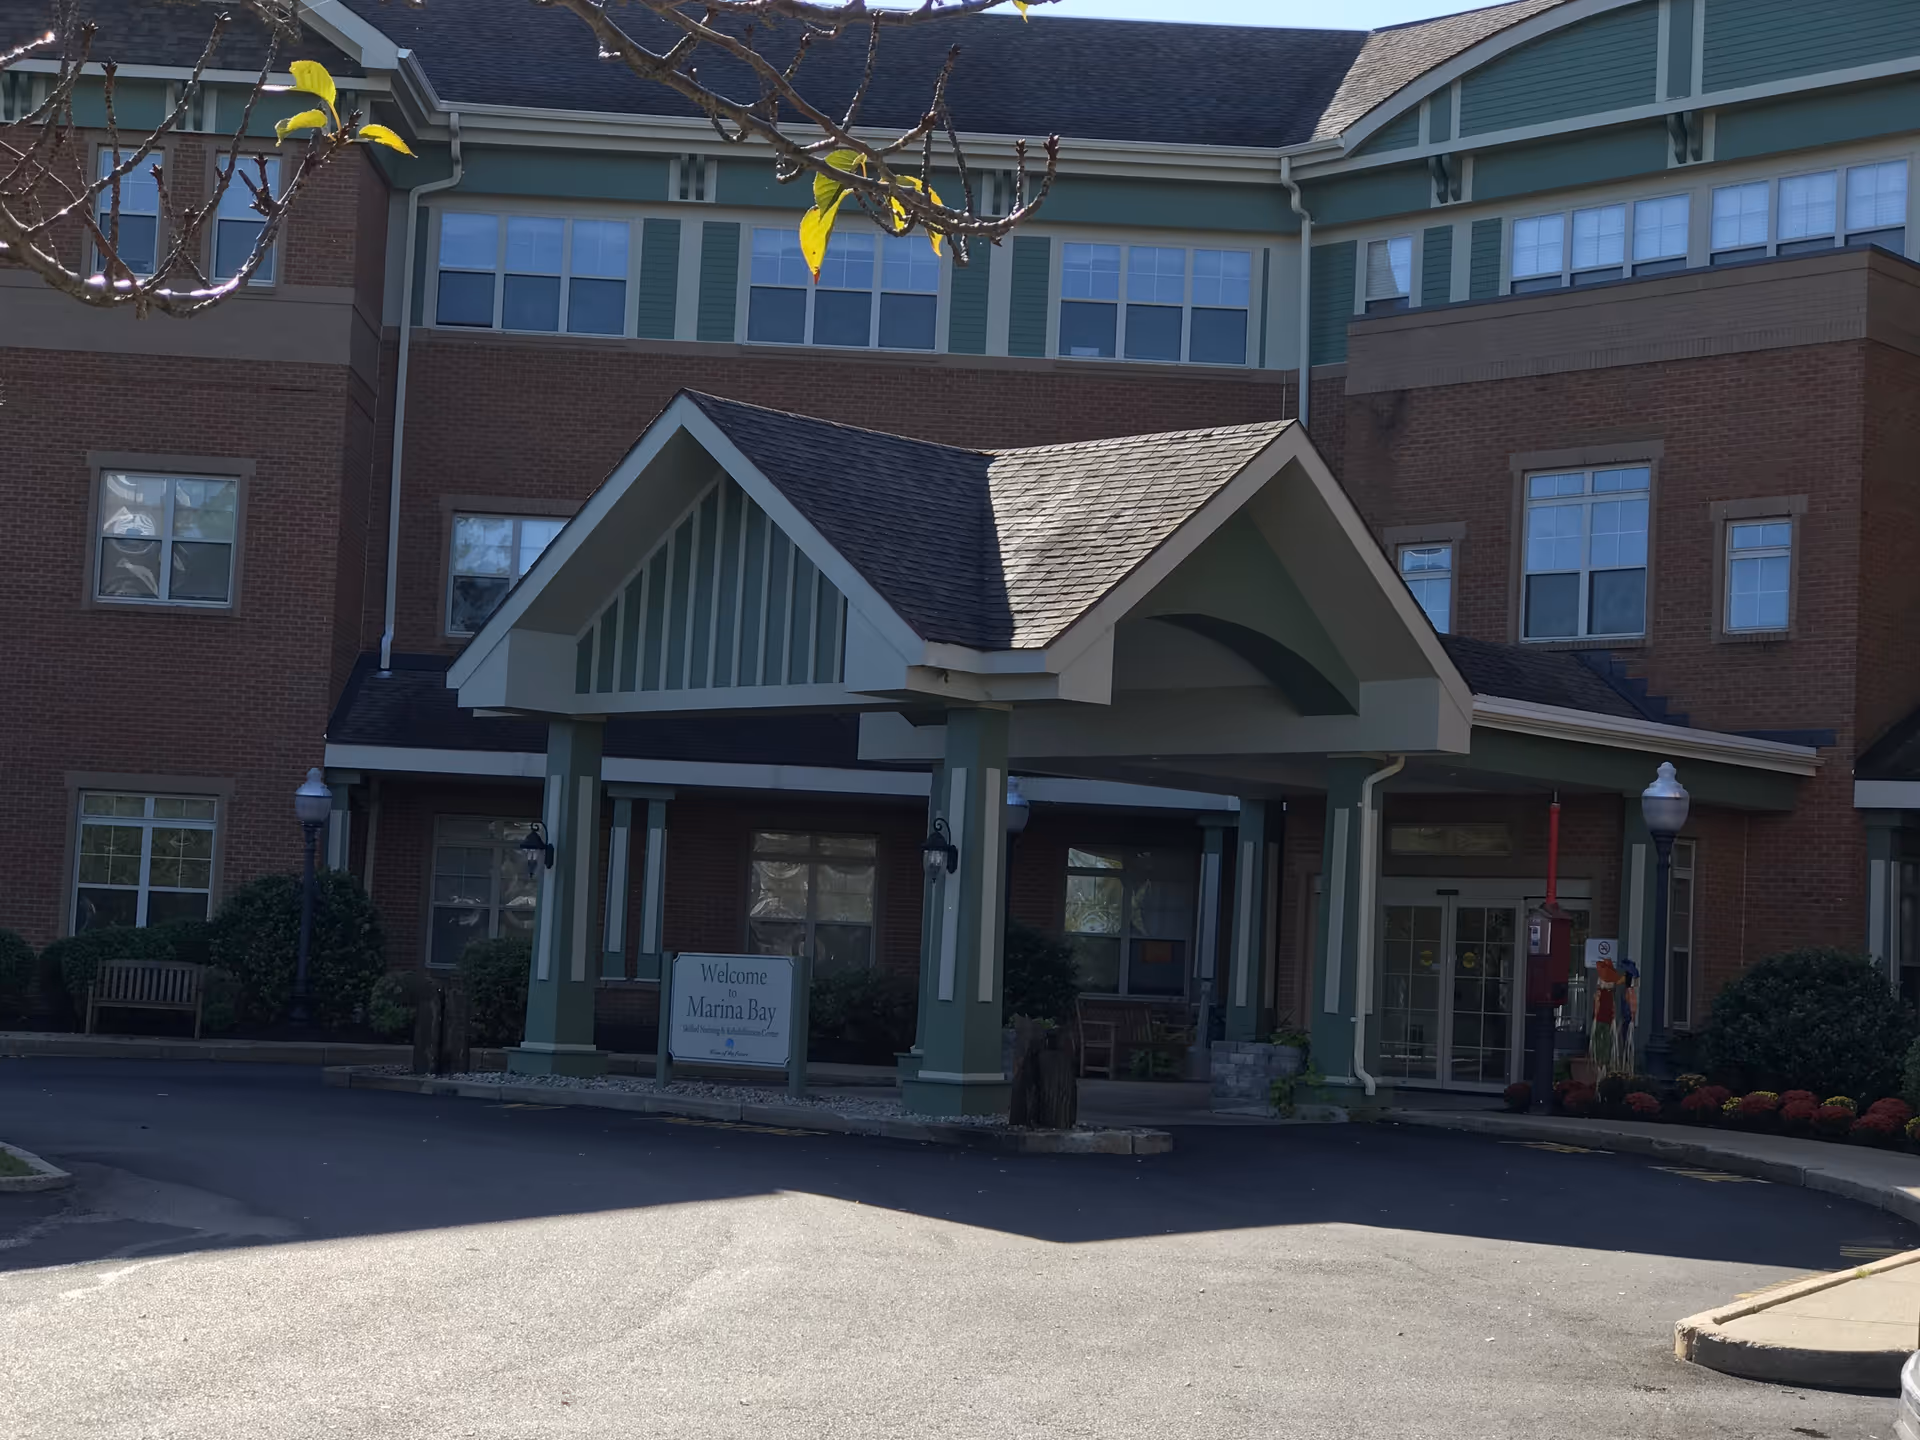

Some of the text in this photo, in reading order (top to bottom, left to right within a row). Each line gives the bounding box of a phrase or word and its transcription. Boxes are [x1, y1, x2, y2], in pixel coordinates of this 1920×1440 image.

[701, 962, 768, 985] Welcome
[728, 988, 737, 998] to
[686, 995, 777, 1030] Marina Bay
